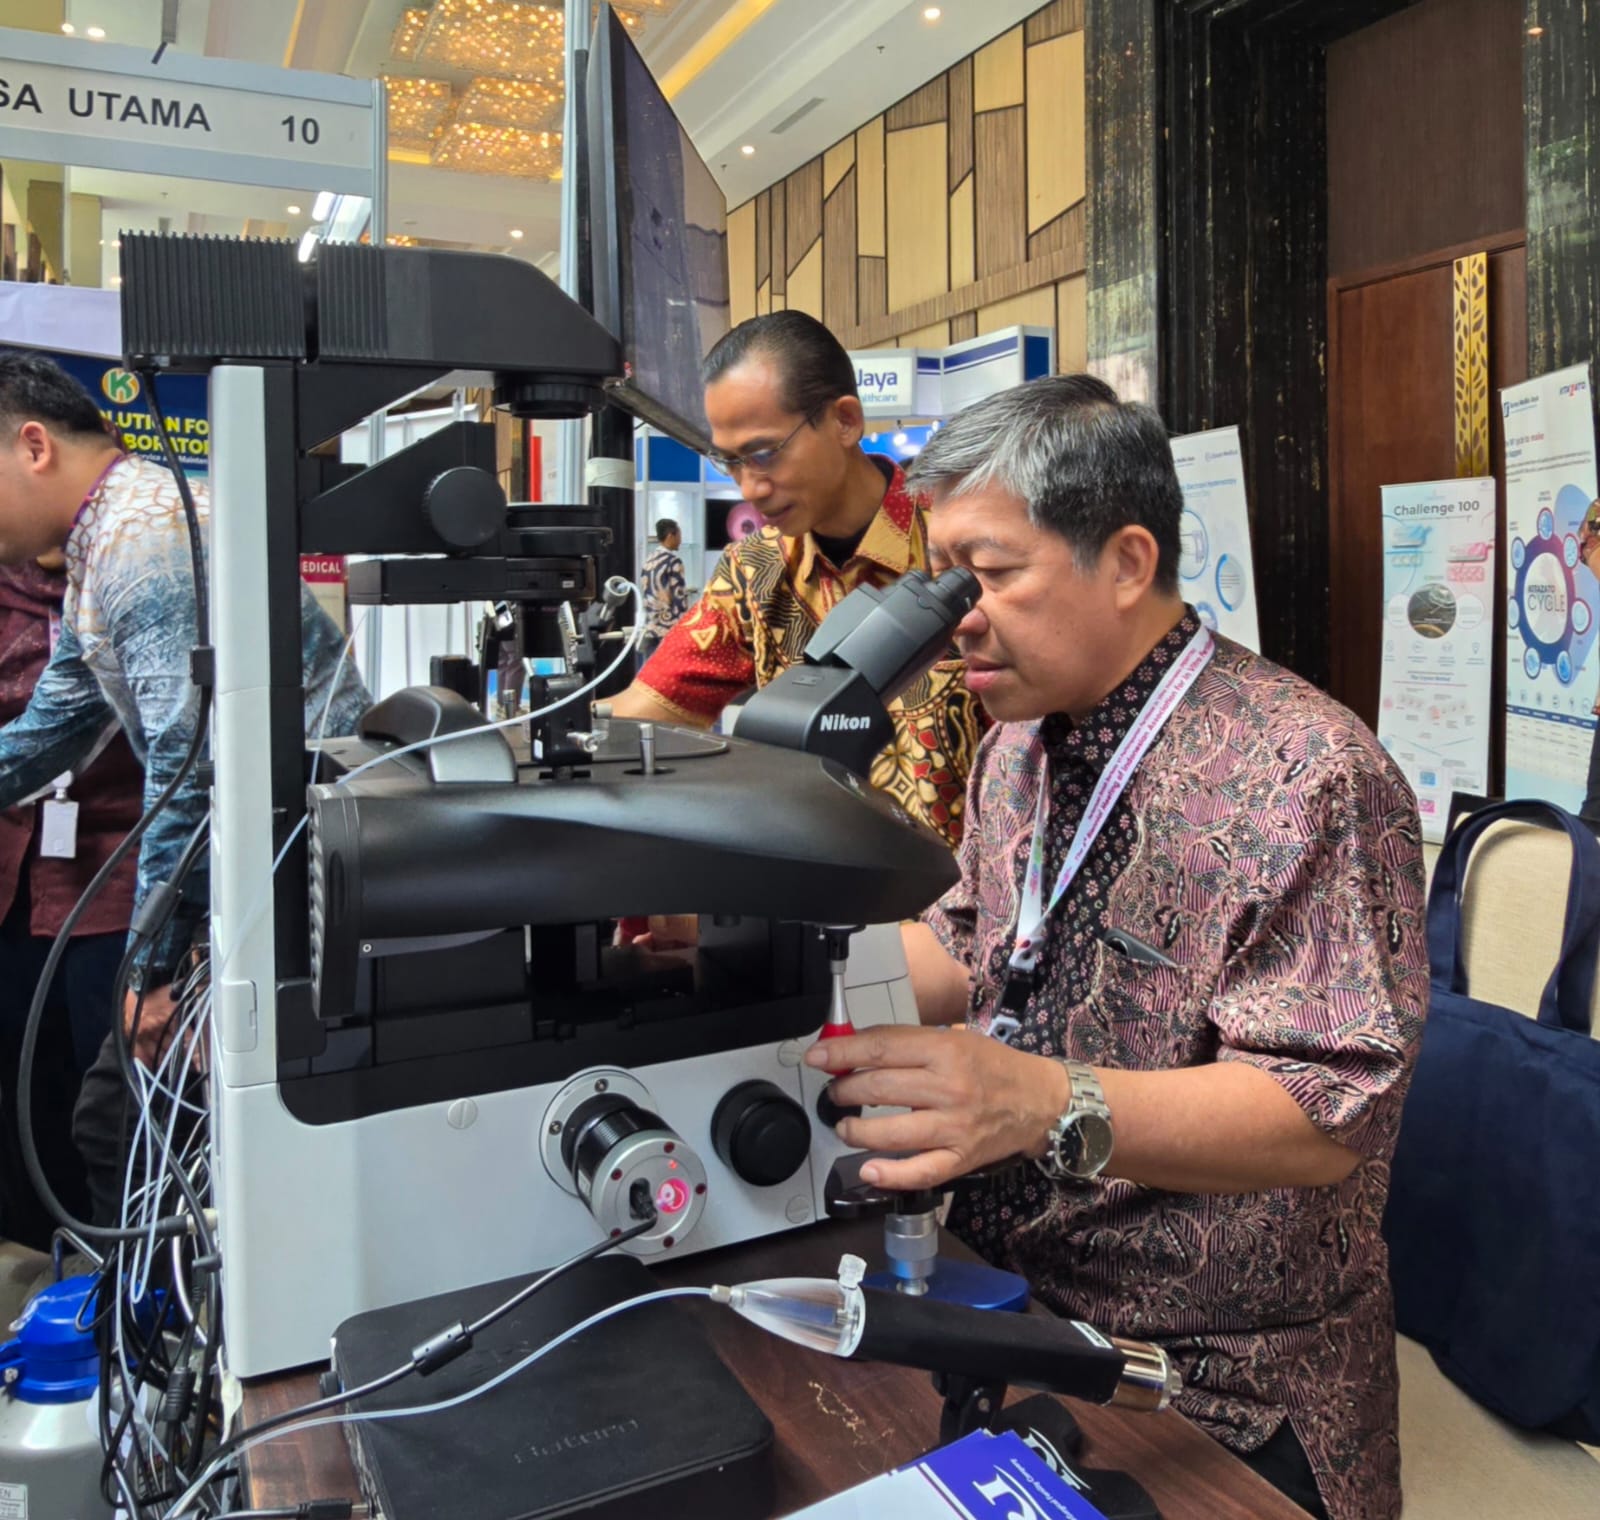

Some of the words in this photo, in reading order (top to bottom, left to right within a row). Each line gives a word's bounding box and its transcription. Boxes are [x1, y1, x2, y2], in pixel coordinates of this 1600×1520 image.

[68, 87, 211, 132] UTAMA
[281, 115, 320, 145] 10
[856, 368, 898, 393] Jaya
[100, 409, 180, 433] LUTIN
[1393, 503, 1455, 516] Challenge
[1458, 500, 1480, 511] 100
[820, 713, 871, 731] Nikon
[1146, 689, 1179, 731] Association
